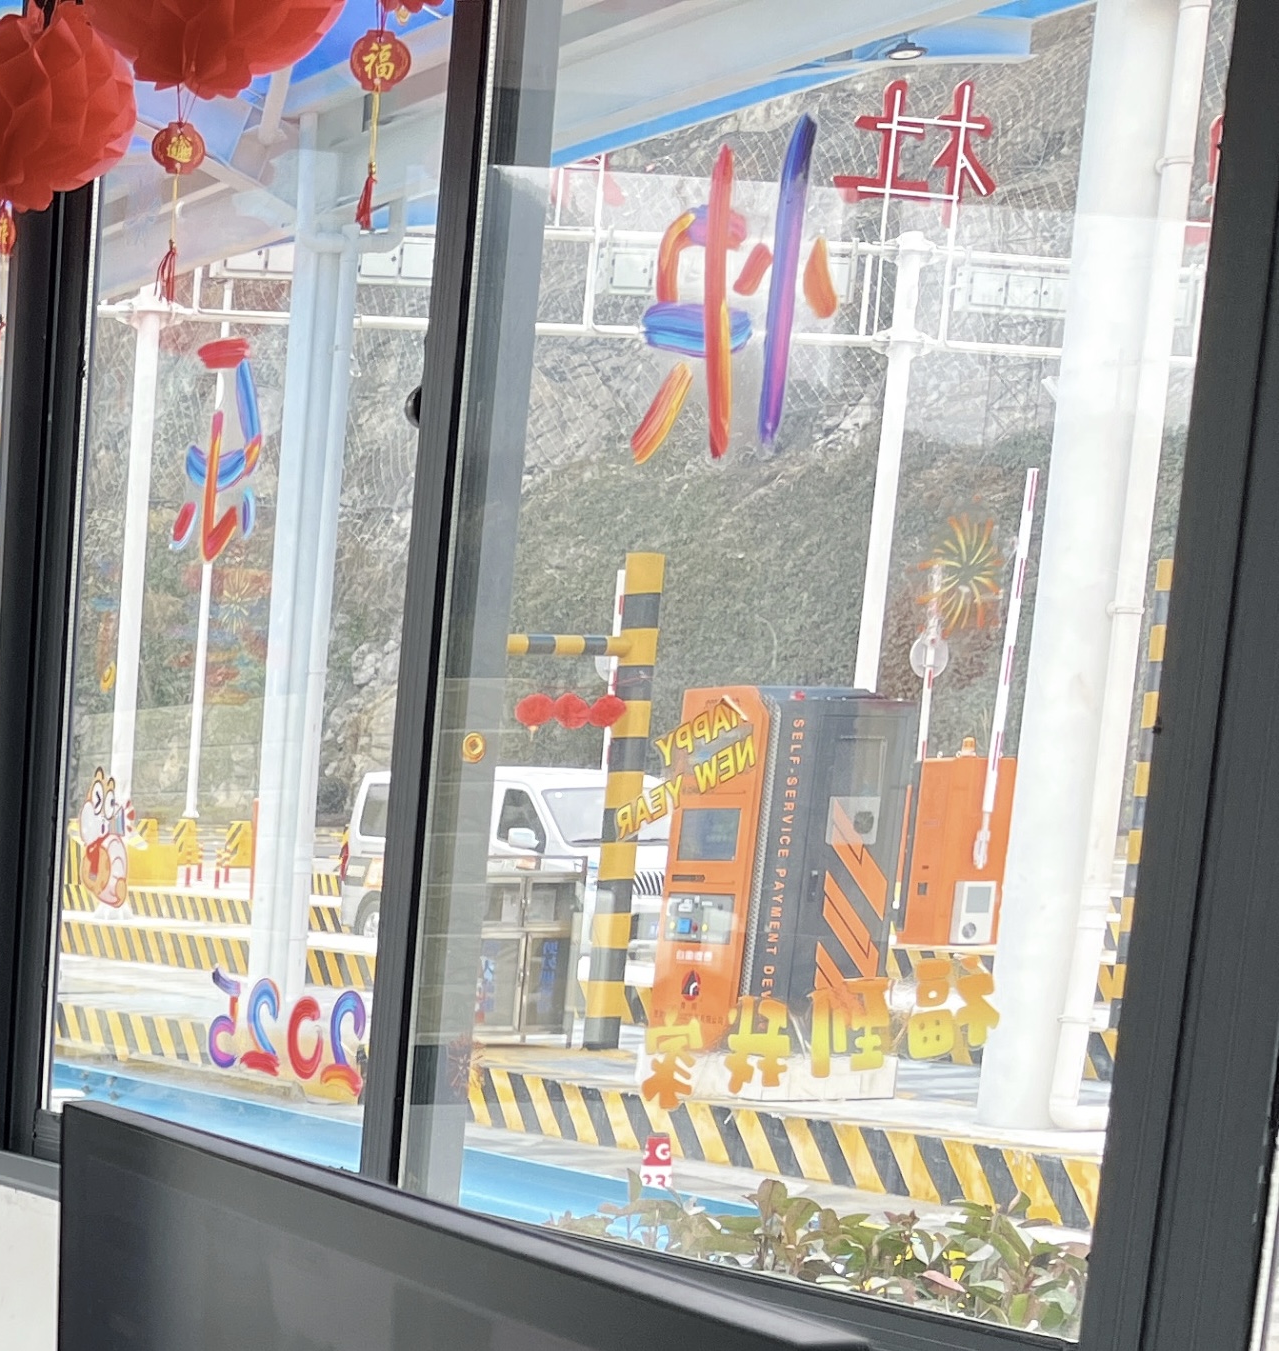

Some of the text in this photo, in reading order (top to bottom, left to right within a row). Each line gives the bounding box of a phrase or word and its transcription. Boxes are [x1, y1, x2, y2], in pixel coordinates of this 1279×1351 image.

[363, 43, 394, 79] 福
[778, 718, 805, 859] SELF-SERVICE
[766, 867, 788, 955] PAYMENT
